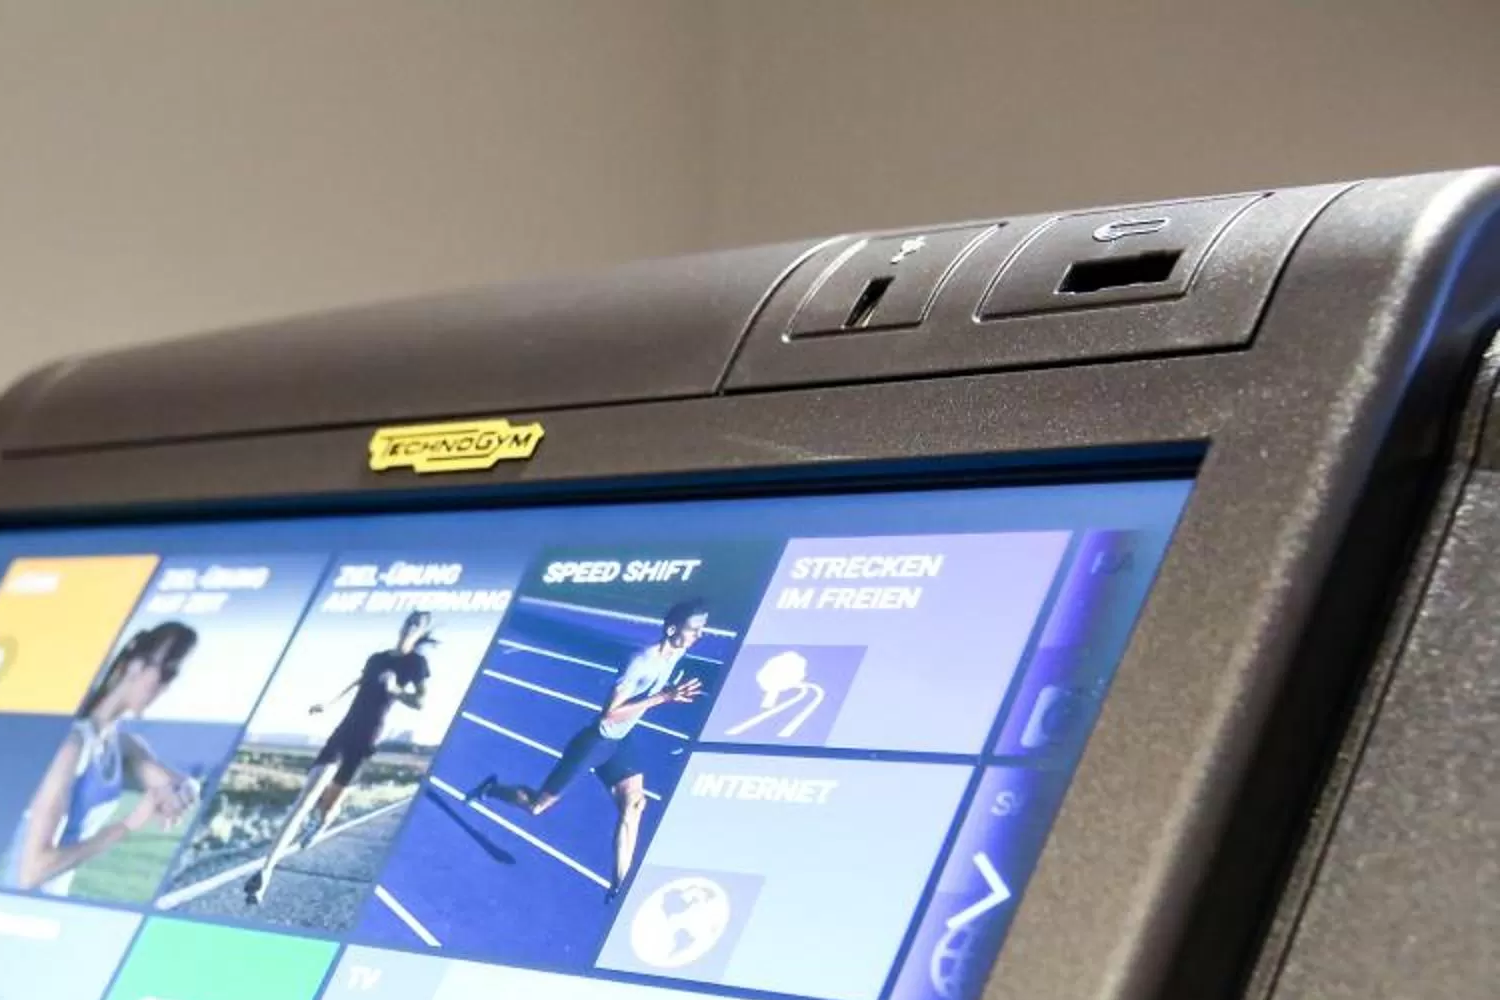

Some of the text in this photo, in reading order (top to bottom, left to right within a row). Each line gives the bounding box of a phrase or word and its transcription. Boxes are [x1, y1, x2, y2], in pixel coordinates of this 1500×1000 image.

[379, 430, 533, 460] TECHNOGYM
[542, 559, 702, 583] SPEED SHIFT
[790, 554, 945, 579] STRECKEN
[776, 586, 922, 609] IM FREIEN
[690, 772, 840, 804] INTERNET
[347, 966, 383, 991] TV
